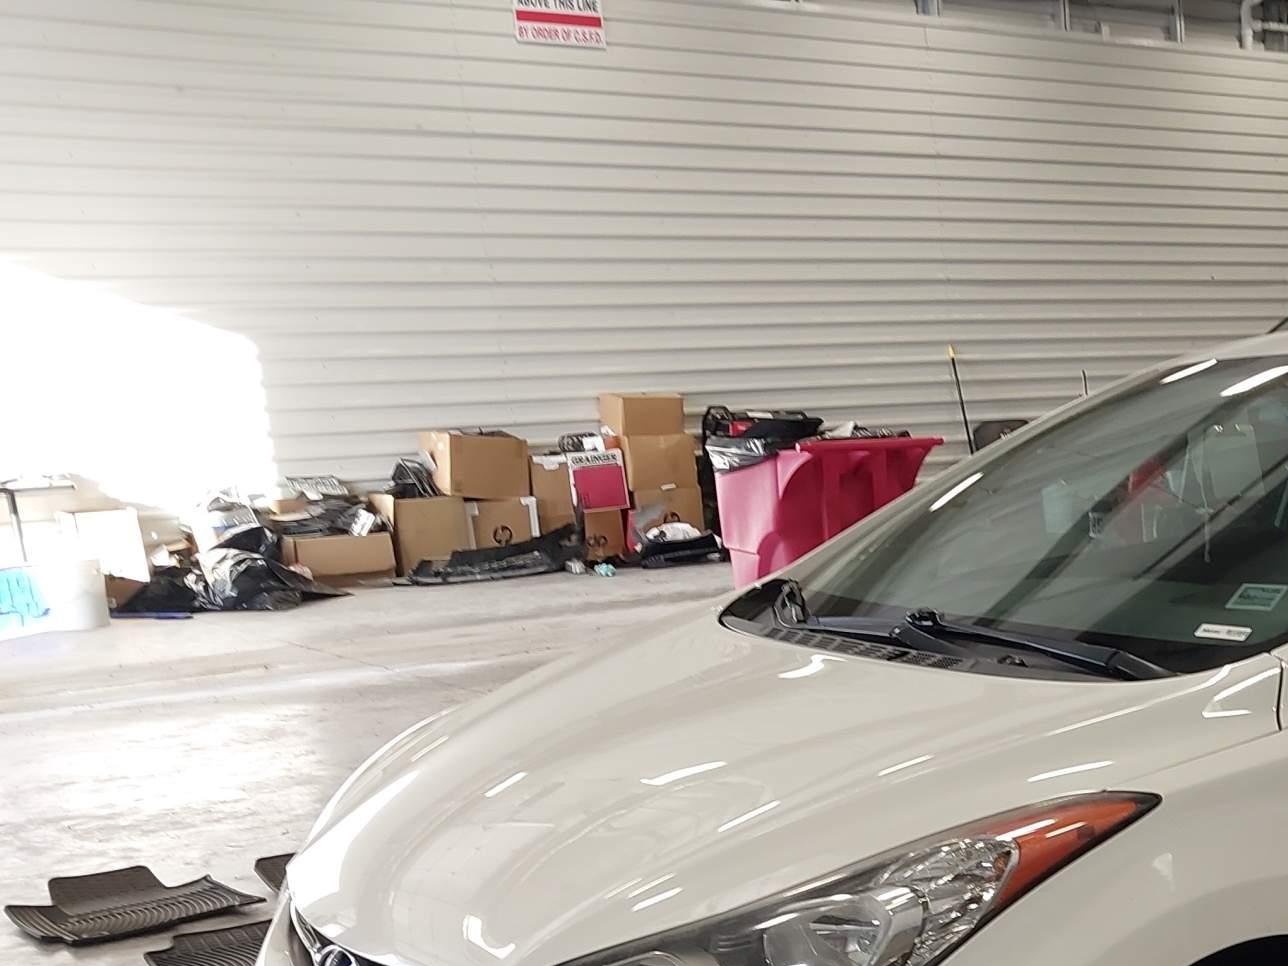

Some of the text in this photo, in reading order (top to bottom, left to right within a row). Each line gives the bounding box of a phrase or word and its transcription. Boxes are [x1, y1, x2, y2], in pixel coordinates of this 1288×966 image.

[576, 0, 598, 13] LINE
[519, 26, 529, 38] BY
[531, 26, 560, 40] ORDER
[561, 28, 572, 41] OF
